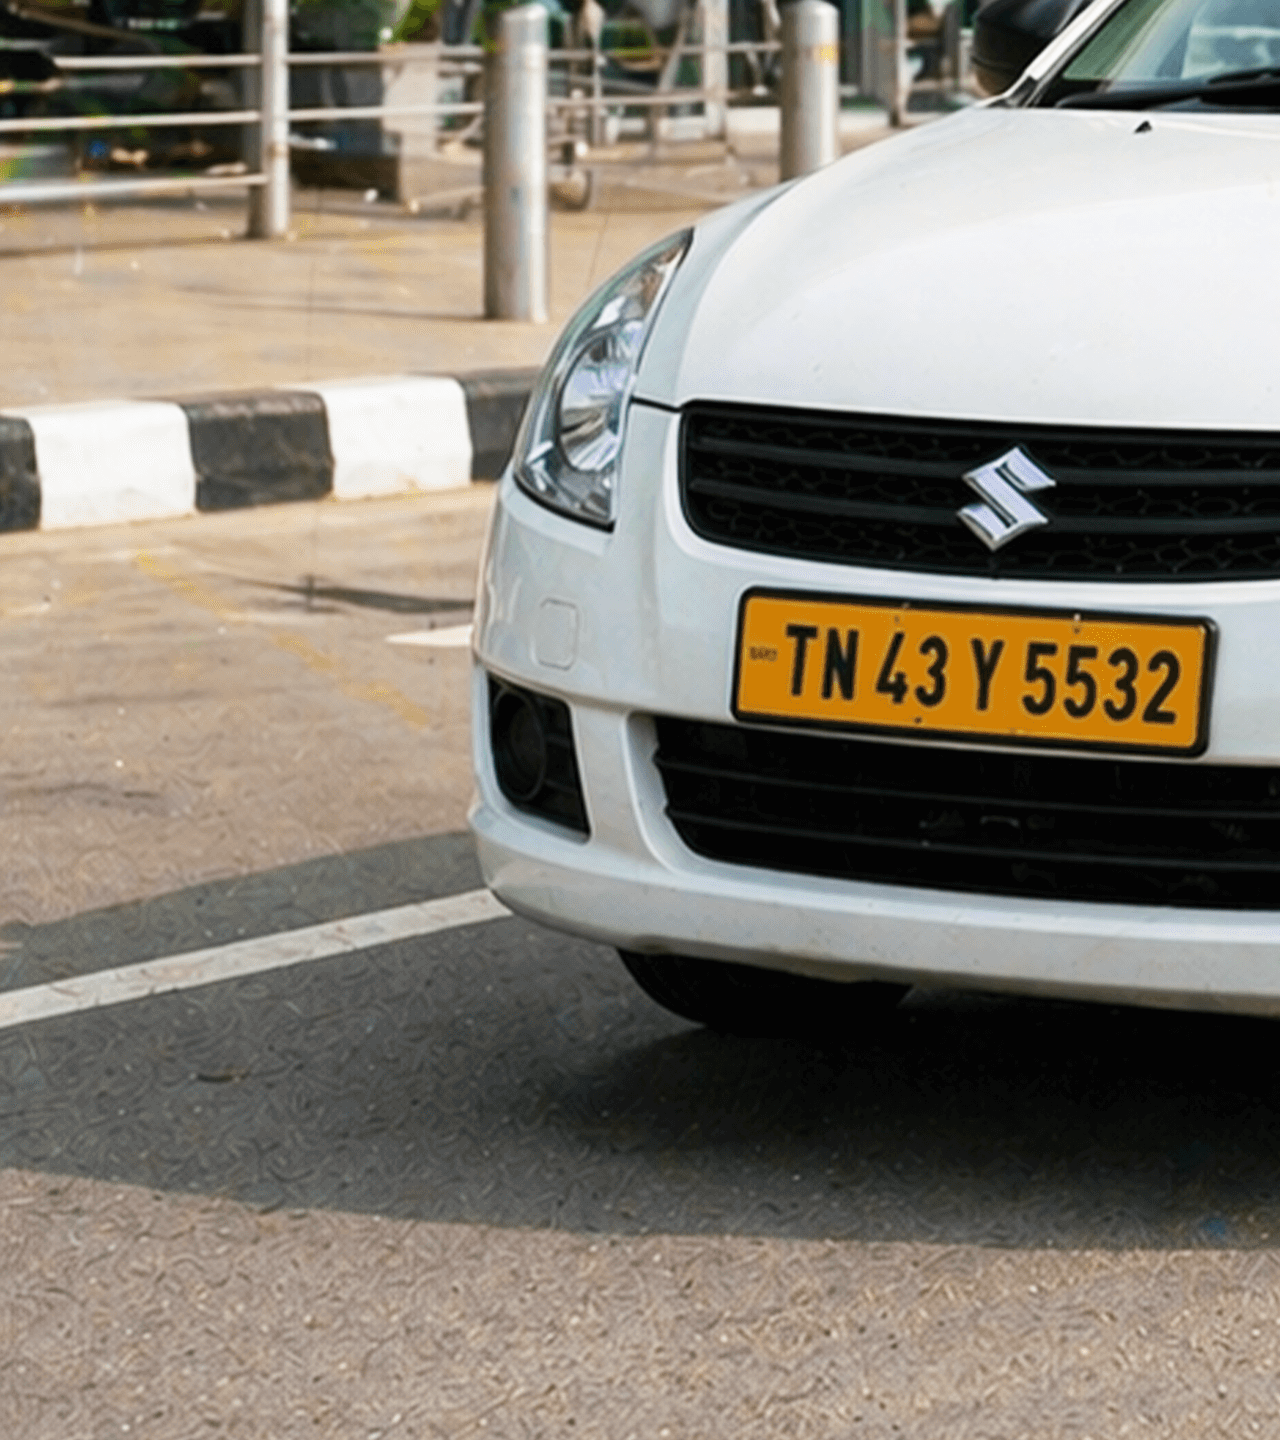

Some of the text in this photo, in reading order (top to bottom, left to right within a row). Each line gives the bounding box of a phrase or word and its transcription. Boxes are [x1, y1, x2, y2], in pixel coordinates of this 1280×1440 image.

[785, 622, 1181, 726] TN 43 Y 5532
